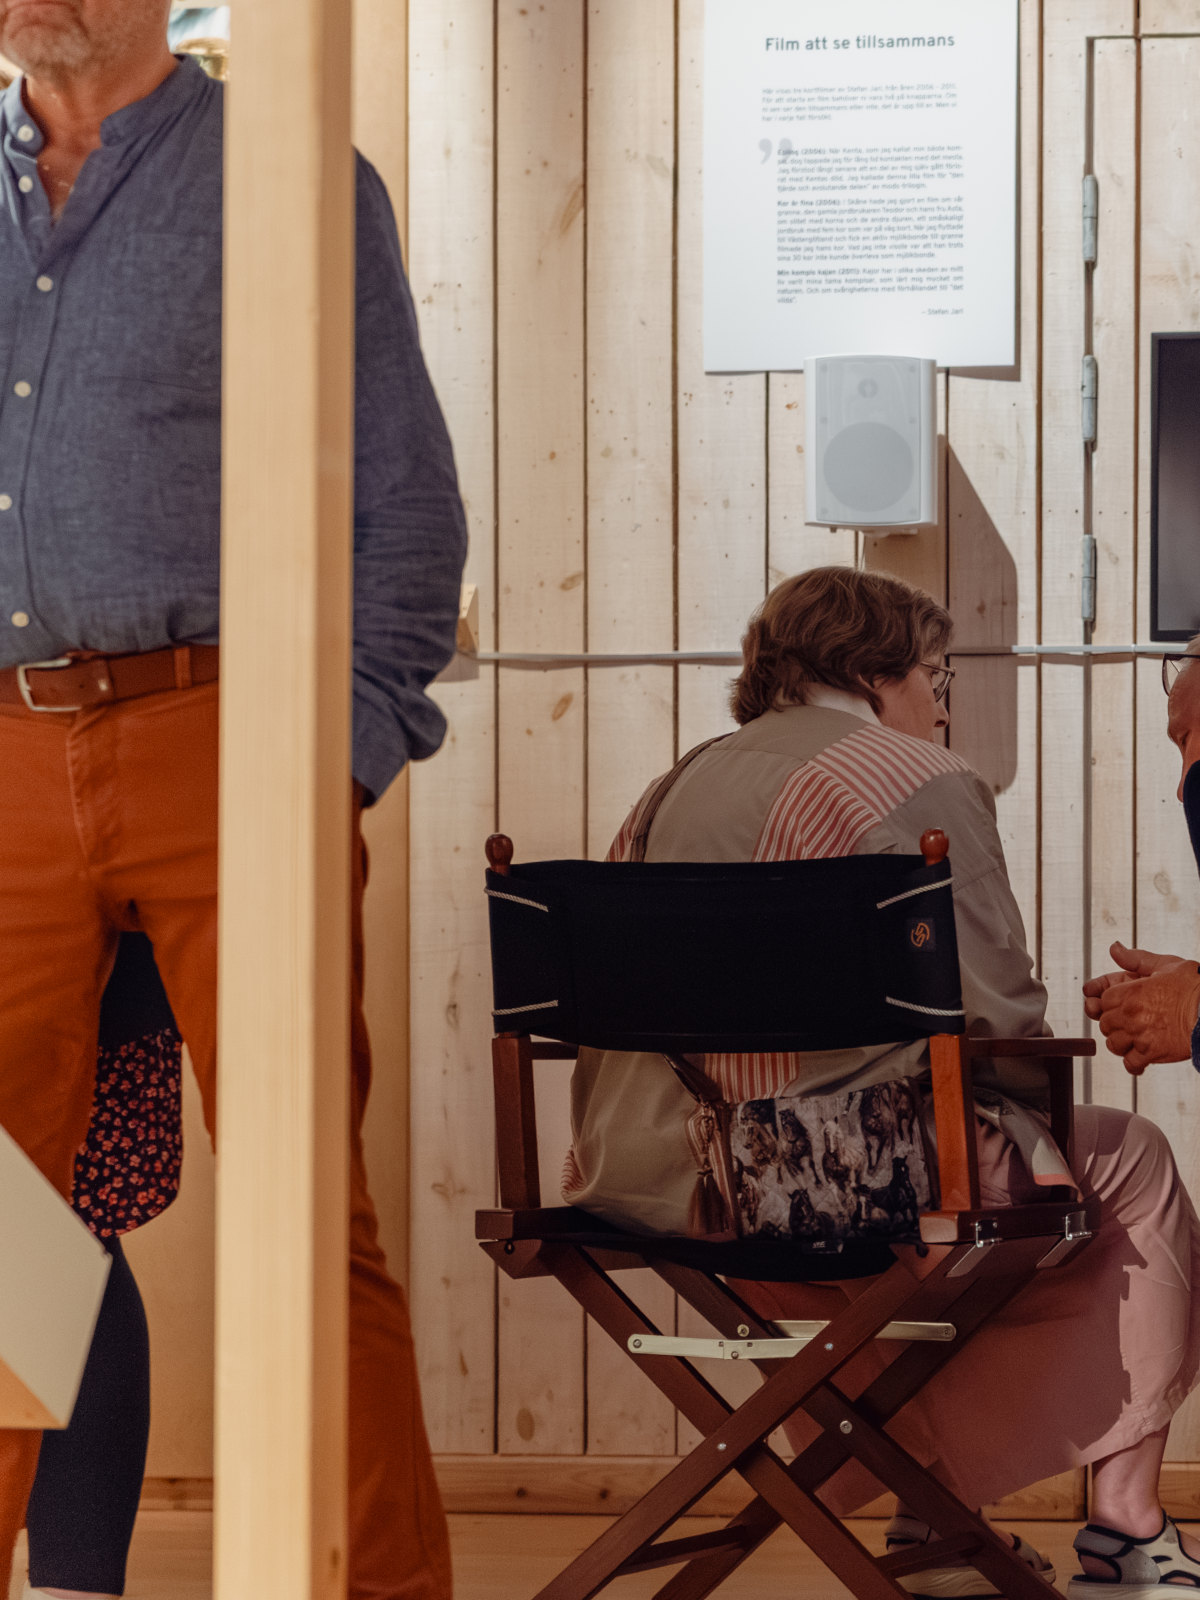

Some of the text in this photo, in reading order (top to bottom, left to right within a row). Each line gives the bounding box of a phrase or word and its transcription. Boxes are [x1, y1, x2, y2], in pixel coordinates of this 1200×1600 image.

[765, 35, 955, 51] Film att se tillsammans
